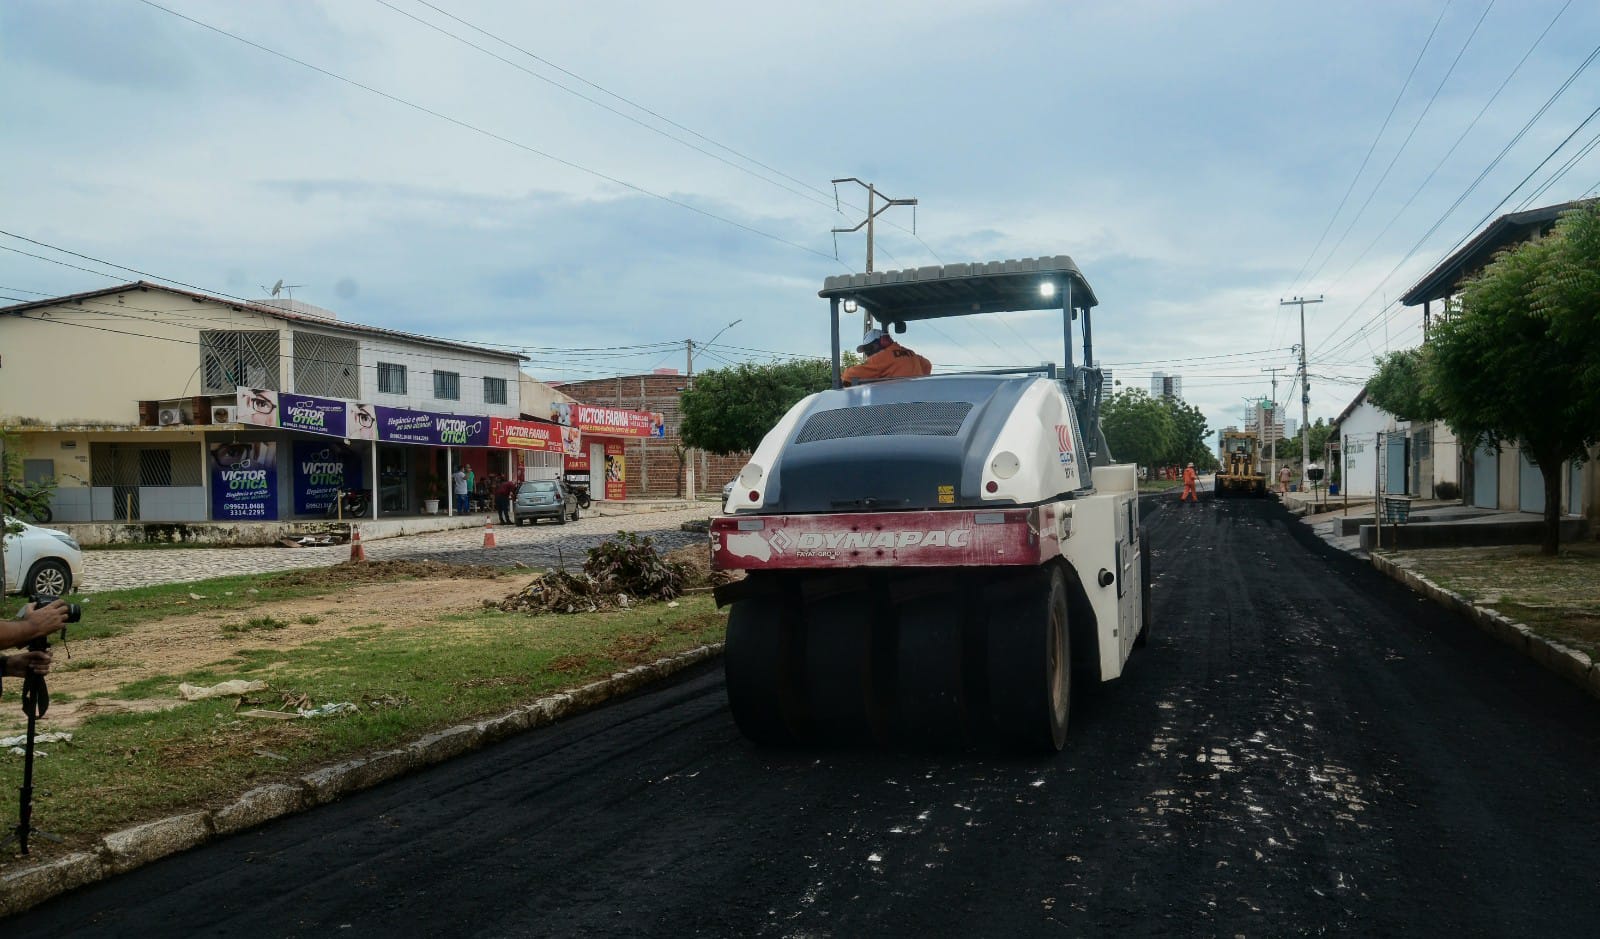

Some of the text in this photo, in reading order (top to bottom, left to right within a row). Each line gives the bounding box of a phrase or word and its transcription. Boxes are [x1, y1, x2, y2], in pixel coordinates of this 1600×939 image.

[288, 406, 325, 418] VICTOR
[579, 407, 629, 427] VICTOR FARMA
[436, 418, 467, 432] VICTOR
[506, 426, 550, 440] VICTOR FARMA
[302, 461, 344, 474] VICTOR
[222, 470, 267, 481] VICTOR
[797, 529, 970, 549] DYNAPAC
